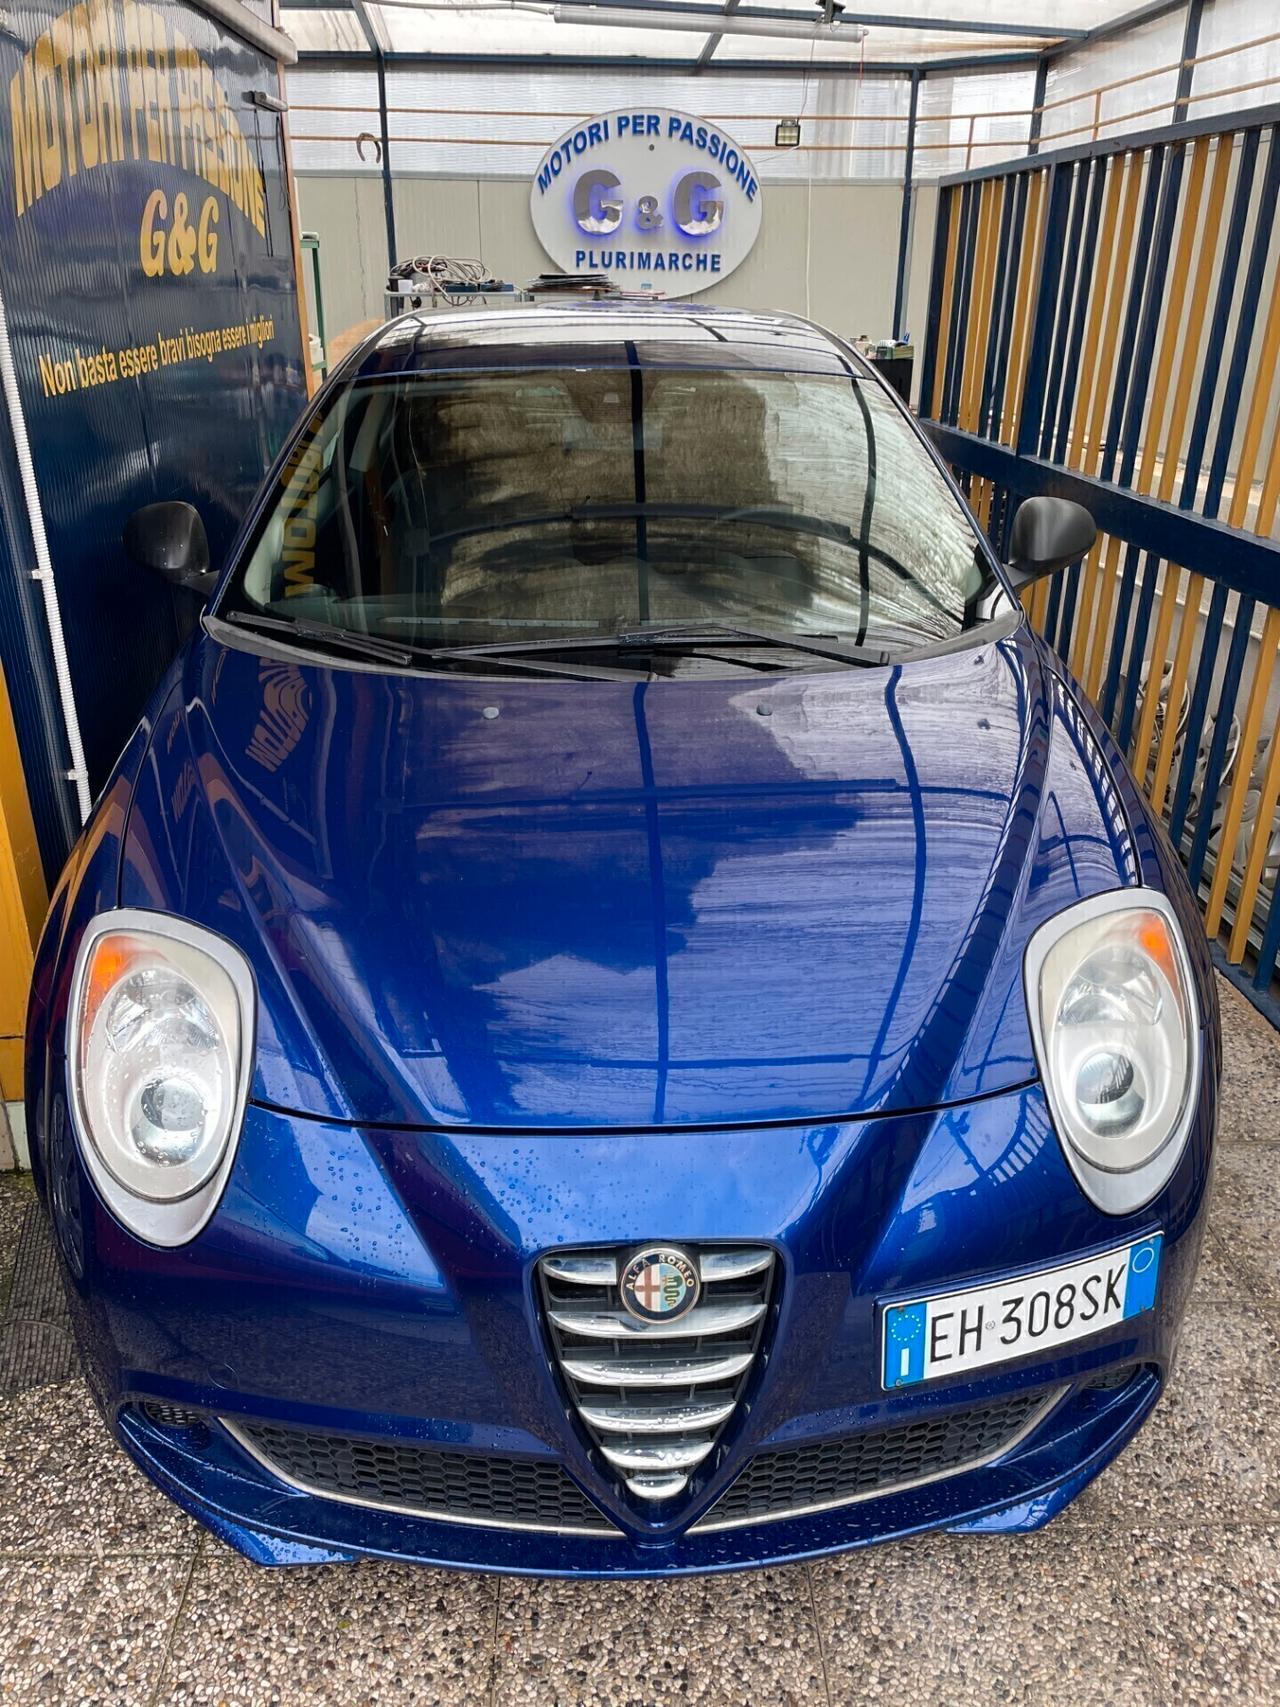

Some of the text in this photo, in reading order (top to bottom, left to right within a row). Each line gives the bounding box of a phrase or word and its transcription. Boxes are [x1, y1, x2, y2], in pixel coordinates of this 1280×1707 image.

[10, 0, 265, 239] MOTORI PER PASSIONE
[537, 114, 759, 203] MOTORI PER PASSIONE
[140, 189, 219, 277] G&G
[575, 250, 721, 272] PLURIMARCHE
[38, 314, 274, 397] Non basta essere bravi bisogna essere i migliori
[626, 1254, 694, 1290] ALFA ROMEO
[930, 1263, 1126, 1363] EH 308SK
[901, 1348, 909, 1376] I
